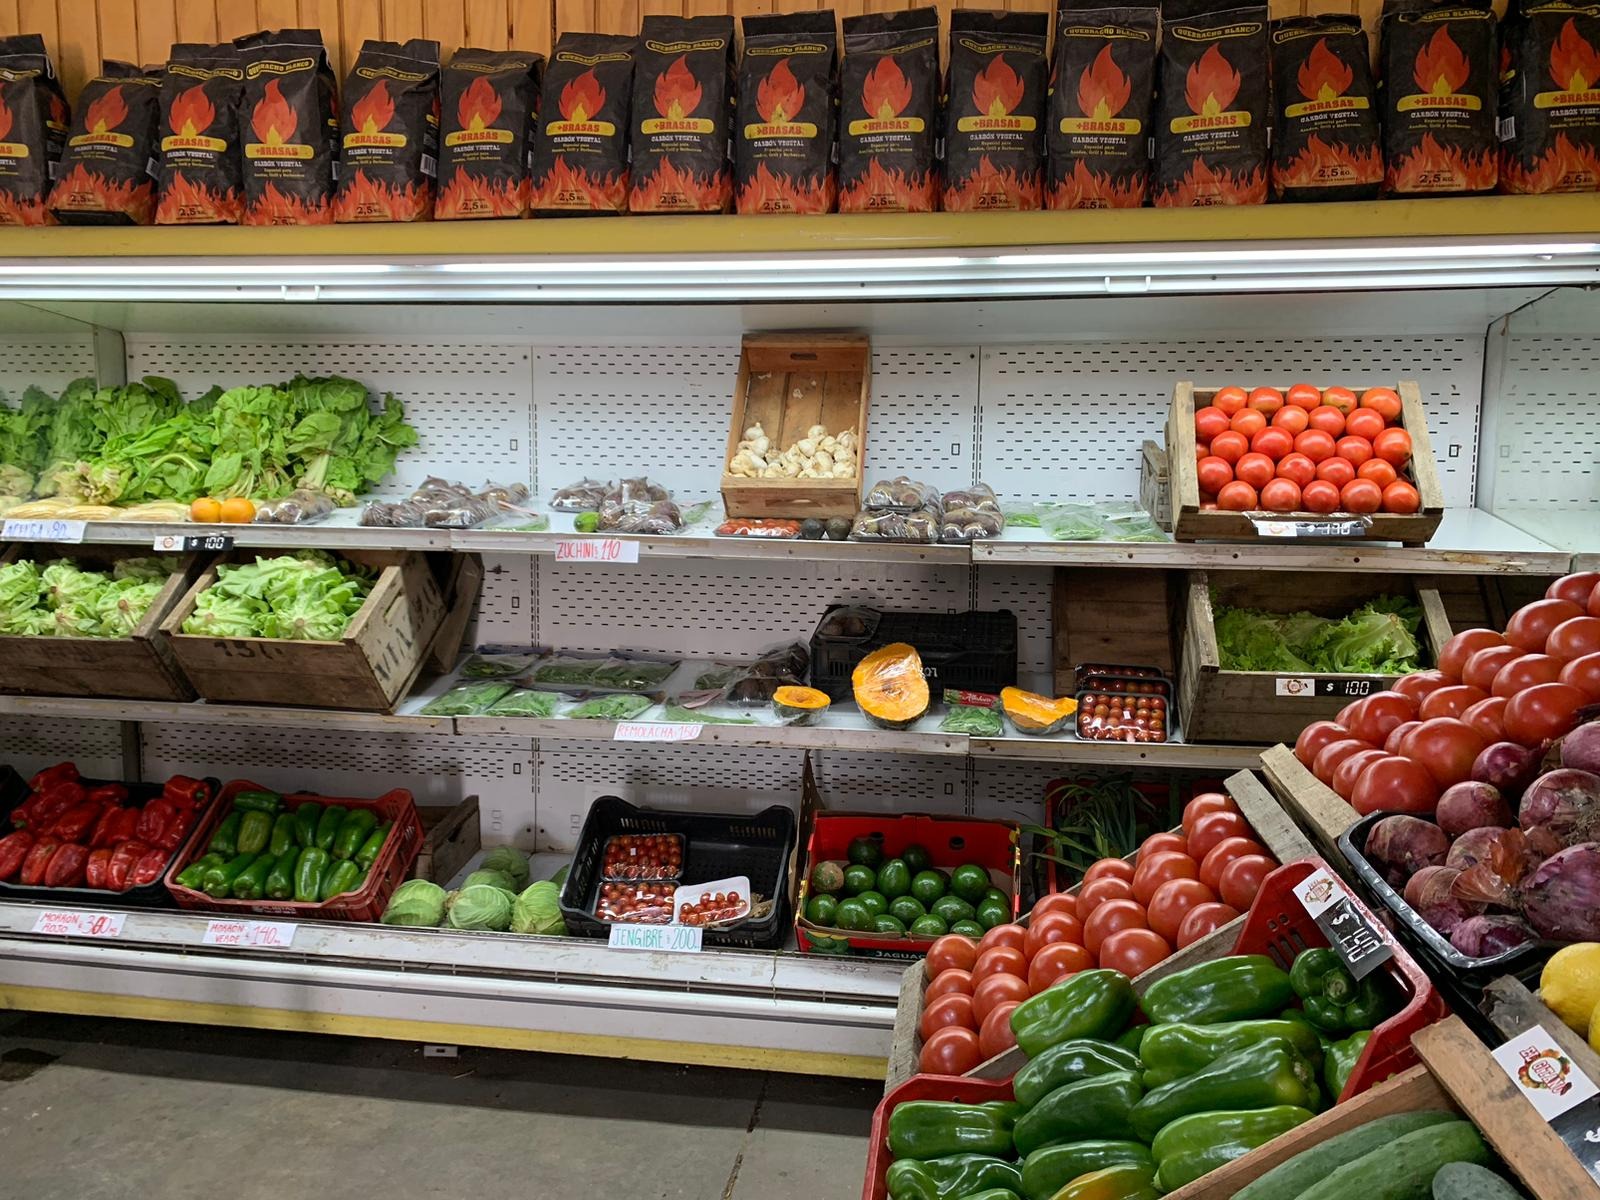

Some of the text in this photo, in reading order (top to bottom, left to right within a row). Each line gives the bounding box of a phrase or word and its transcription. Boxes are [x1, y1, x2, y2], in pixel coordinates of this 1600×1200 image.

[1069, 27, 1113, 36] QUEBRACHO
[1177, 25, 1256, 39] QUEBRACHO BLANCO
[286, 61, 310, 70] BLANCO
[1415, 97, 1467, 106] +BRASAS
[1552, 92, 1600, 103] +BRASA
[1302, 99, 1354, 111] +BRASAS
[1330, 111, 1359, 119] VEGETAL
[654, 121, 699, 130] +BRASAS
[862, 121, 910, 131] +BRASAS
[972, 119, 1021, 129] +BRASAS
[1076, 121, 1126, 132] +BRASAS
[1187, 115, 1237, 128] +BRASAS
[557, 124, 600, 133] +BRASAS
[351, 135, 392, 145] +BRASAS
[457, 131, 498, 141] +BRASAS
[256, 146, 298, 156] +BRASAS
[204, 536, 225, 549] 100
[600, 540, 621, 560] 110
[1326, 681, 1370, 695] $ 100
[680, 725, 700, 739] 150
[613, 928, 664, 949] JENGIBRE
[1330, 912, 1381, 964] $ 140
[1519, 1045, 1541, 1064] EL
